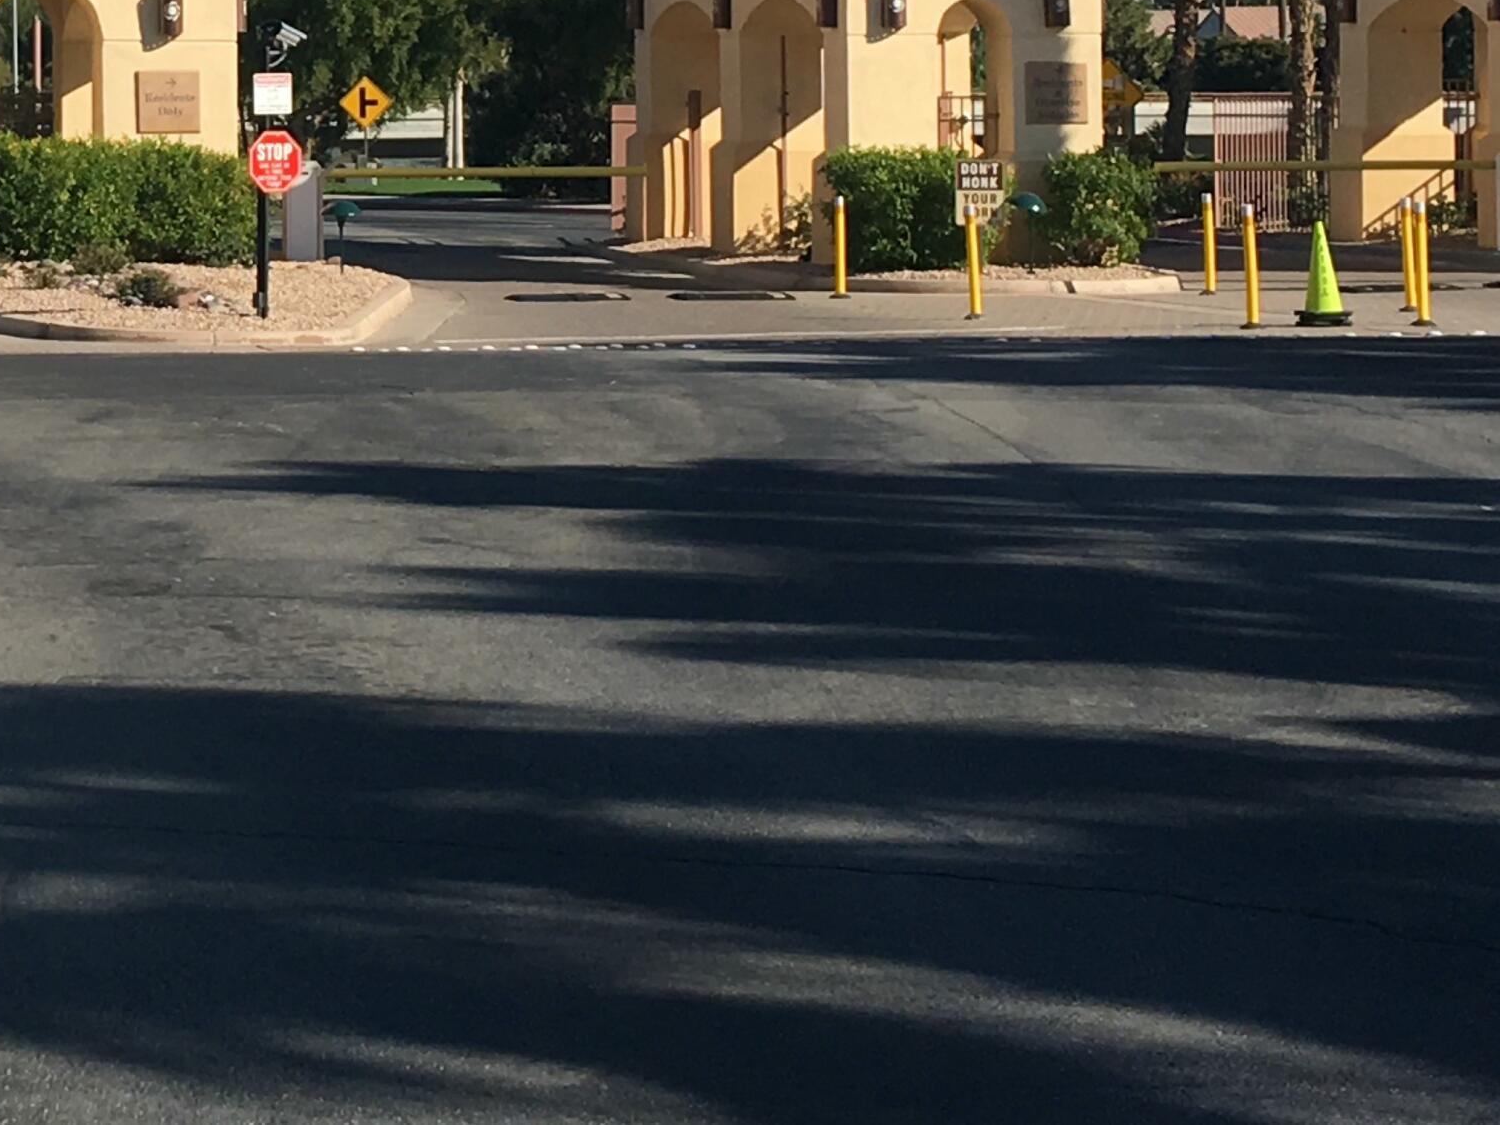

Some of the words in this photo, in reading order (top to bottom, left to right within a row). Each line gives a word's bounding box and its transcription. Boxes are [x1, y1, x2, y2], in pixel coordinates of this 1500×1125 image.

[257, 142, 293, 161] STOP
[960, 162, 999, 175] DON'T
[962, 176, 998, 189] HONK
[963, 193, 998, 204] YOUR
